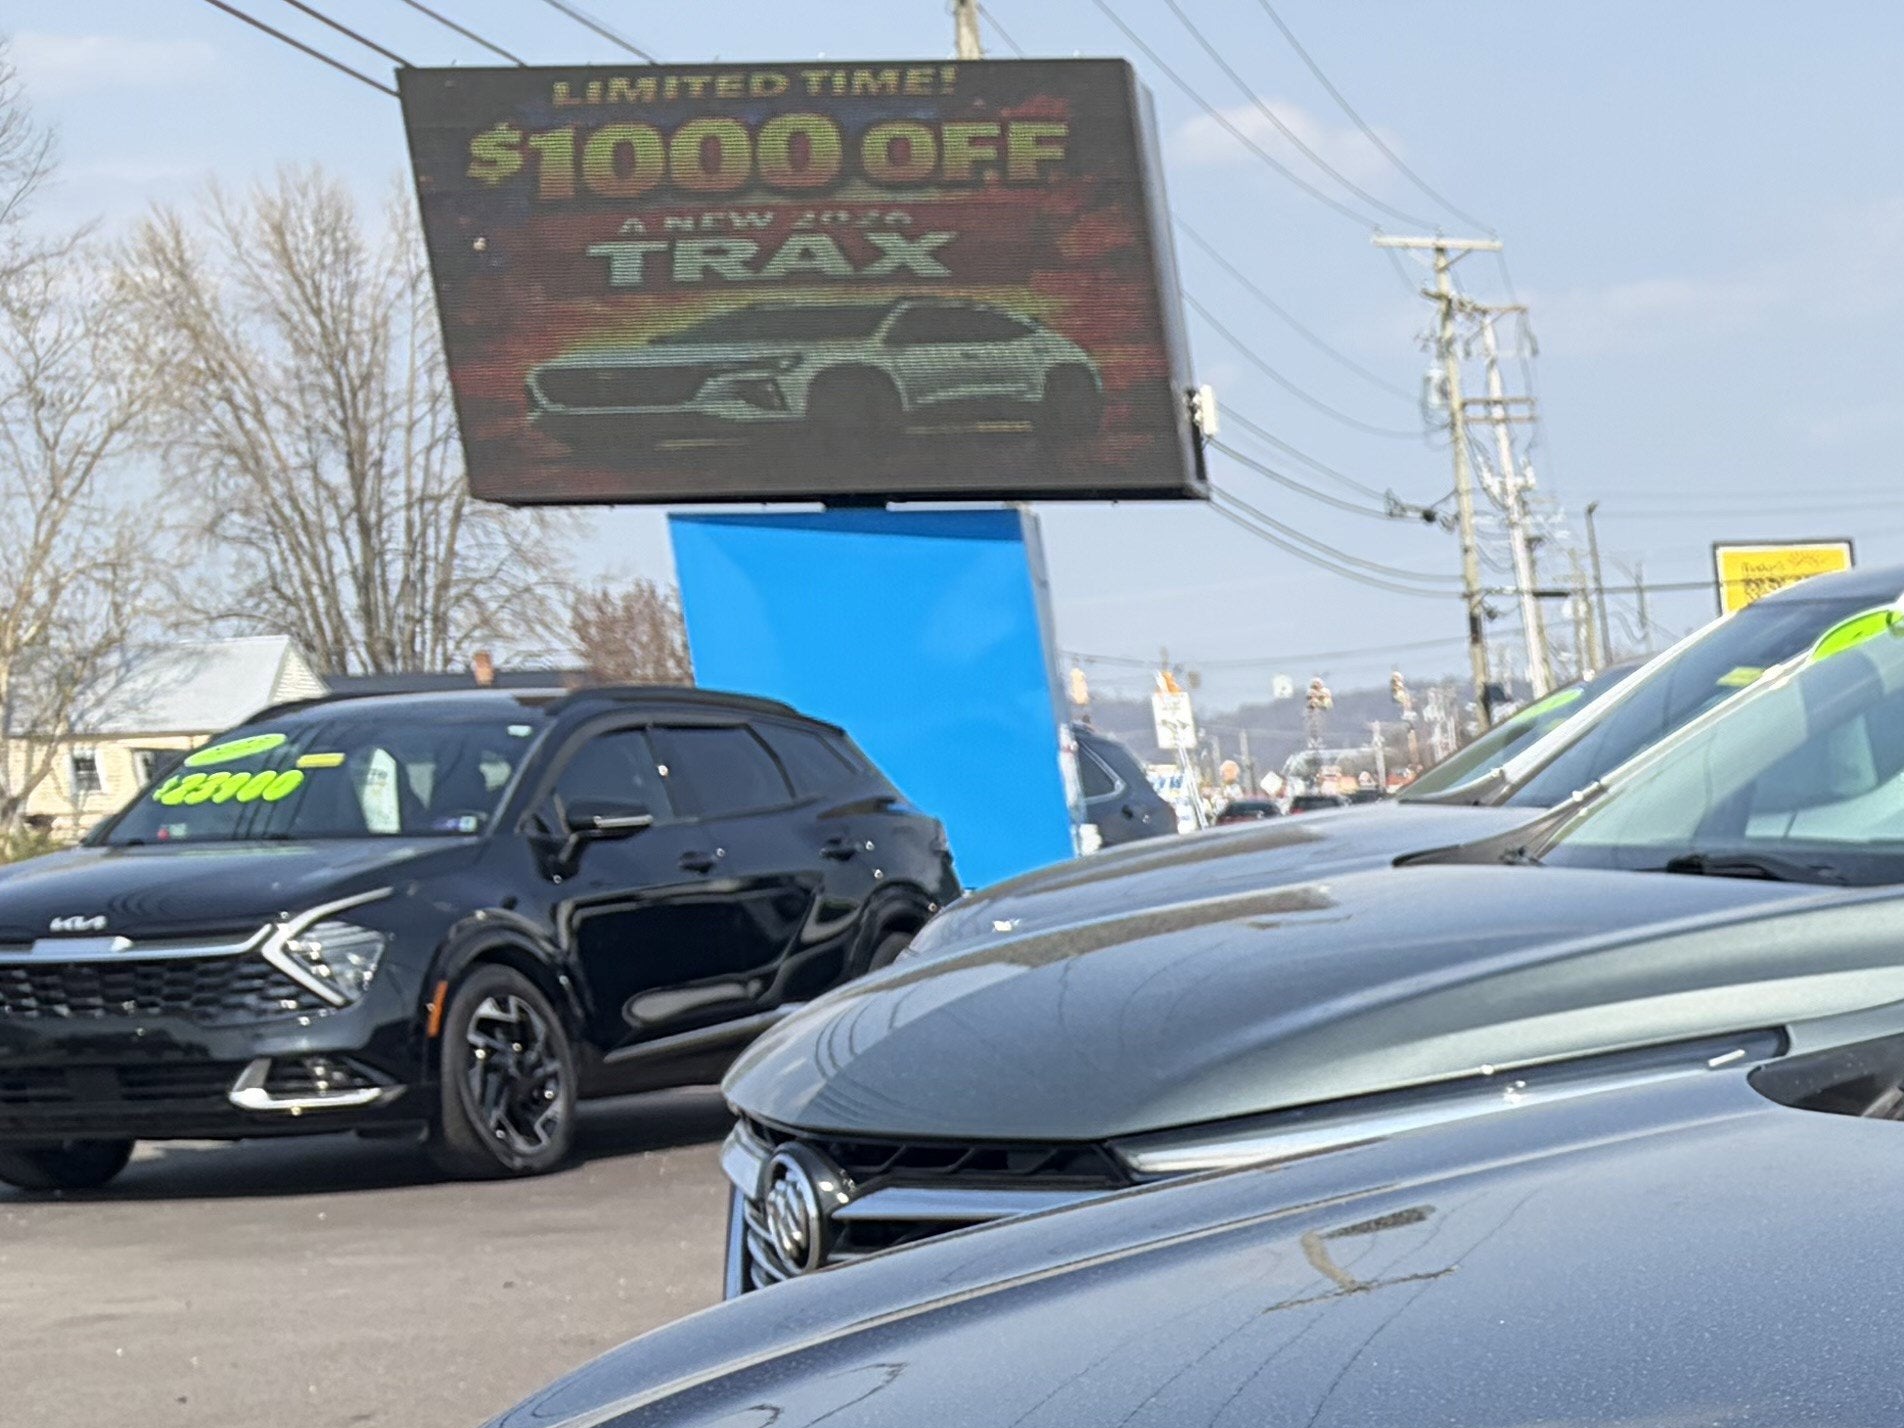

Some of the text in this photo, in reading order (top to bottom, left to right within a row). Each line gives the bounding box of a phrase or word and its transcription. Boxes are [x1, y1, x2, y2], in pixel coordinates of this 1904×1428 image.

[553, 65, 958, 106] LIMITED TIME!
[466, 112, 1069, 201] $1000 OFF
[663, 210, 775, 233] NEW
[584, 230, 957, 287] TRAX
